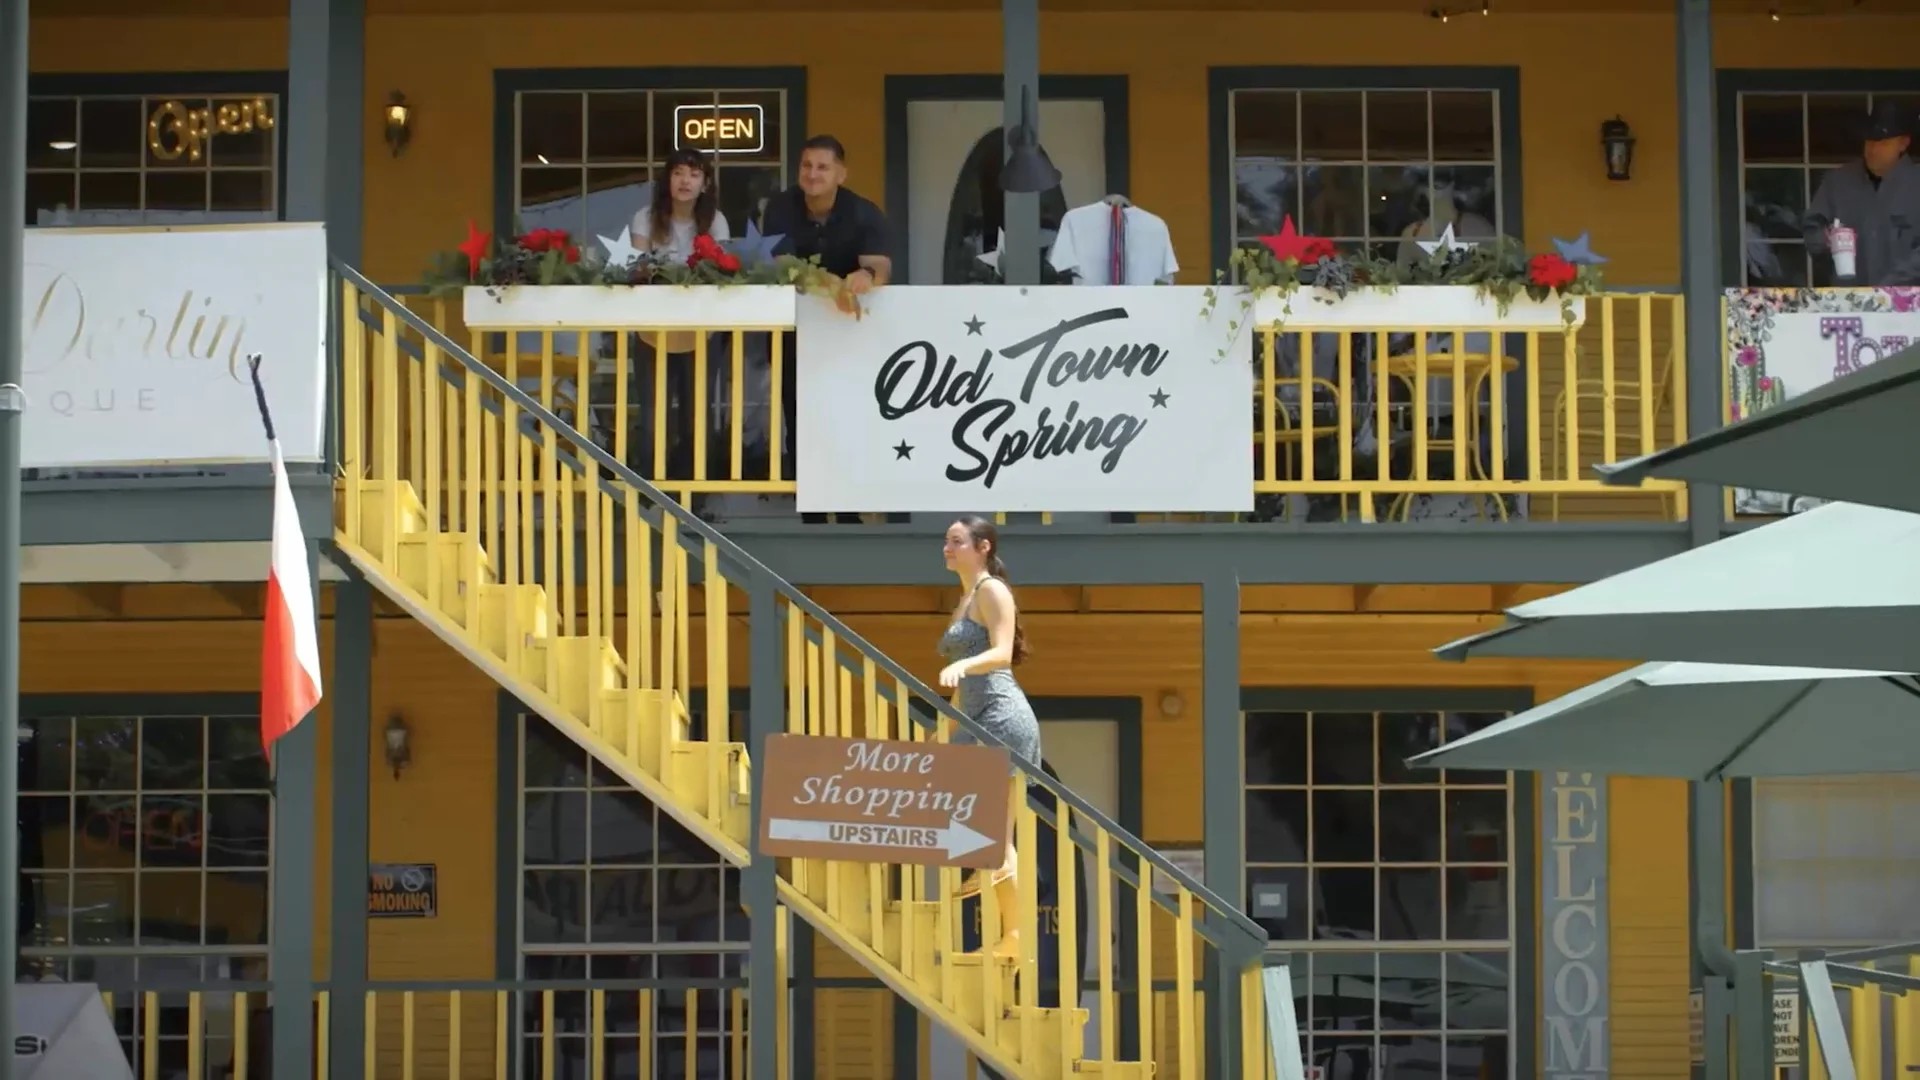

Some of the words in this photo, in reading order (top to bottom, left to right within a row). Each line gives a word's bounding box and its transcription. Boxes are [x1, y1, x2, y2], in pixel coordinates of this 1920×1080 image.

[148, 97, 275, 161] Open
[684, 118, 754, 139] OPEN
[874, 340, 994, 420] Old
[998, 307, 1169, 404] Town
[50, 389, 155, 416] QUE
[945, 398, 1148, 489] Spring
[844, 742, 935, 774] More
[793, 775, 978, 821] Shopping
[829, 823, 938, 847] UPSTAIRS
[371, 874, 393, 891] NO
[1545, 772, 1608, 1080] ELCOM
[1774, 1000, 1793, 1009] ASE
[1773, 1023, 1789, 1033] AVE
[1773, 1035, 1799, 1045] DREN
